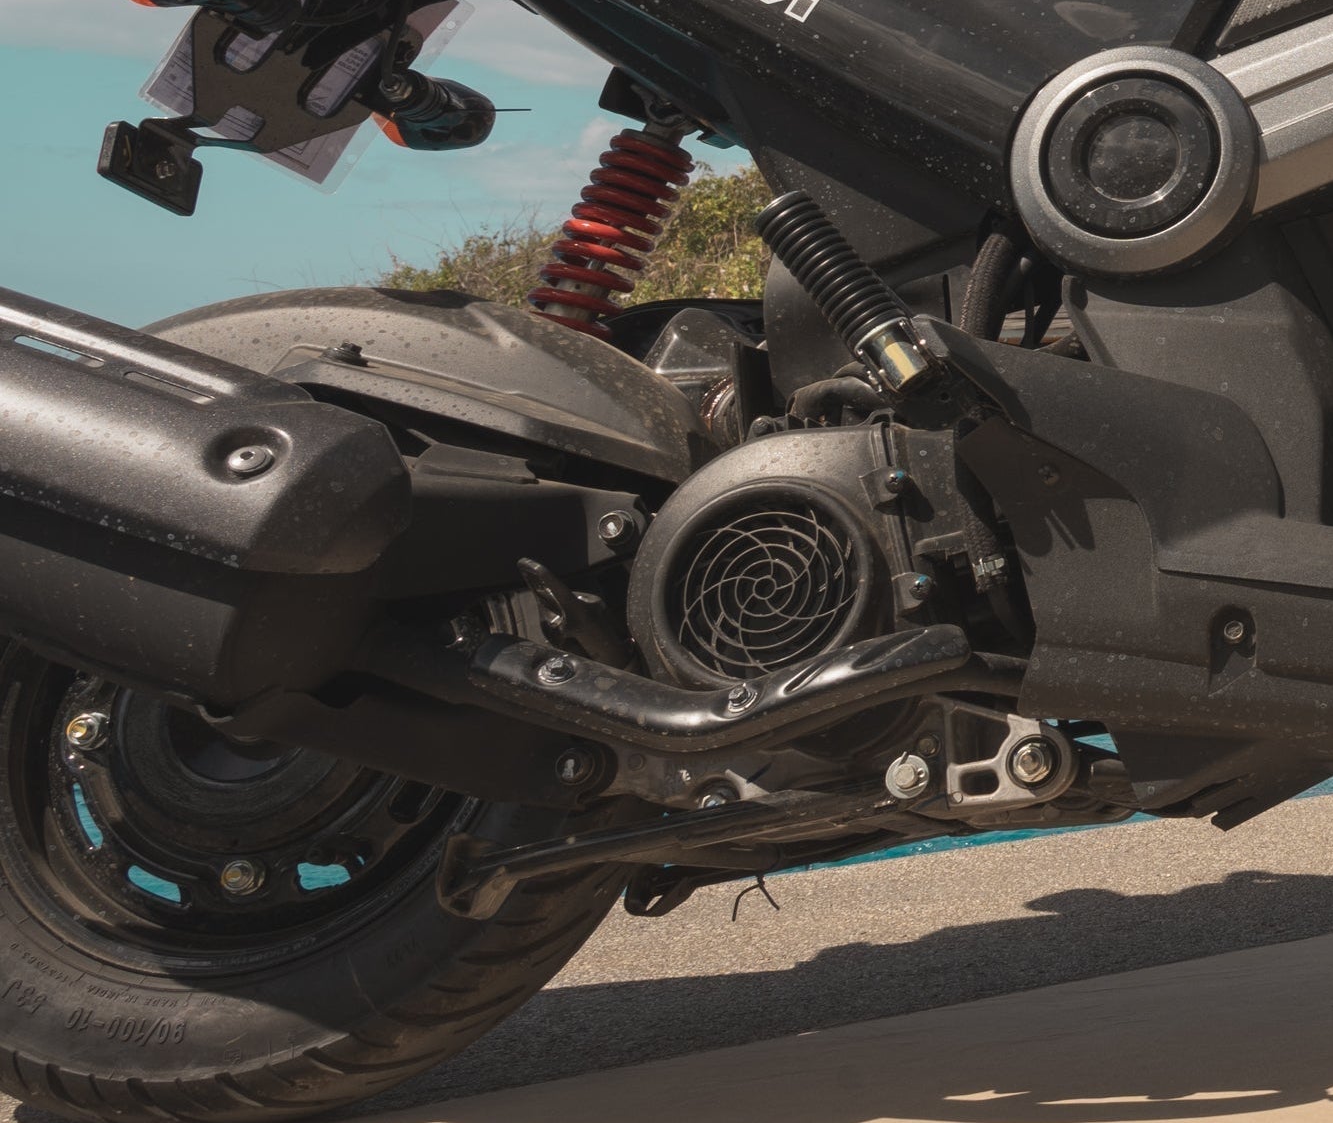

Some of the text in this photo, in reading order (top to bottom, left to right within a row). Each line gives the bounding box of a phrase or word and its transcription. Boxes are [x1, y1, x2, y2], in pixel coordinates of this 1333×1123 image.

[123, 994, 139, 1007] IN
[142, 996, 179, 1009] MADE
[65, 1006, 188, 1048] 90/100-10
